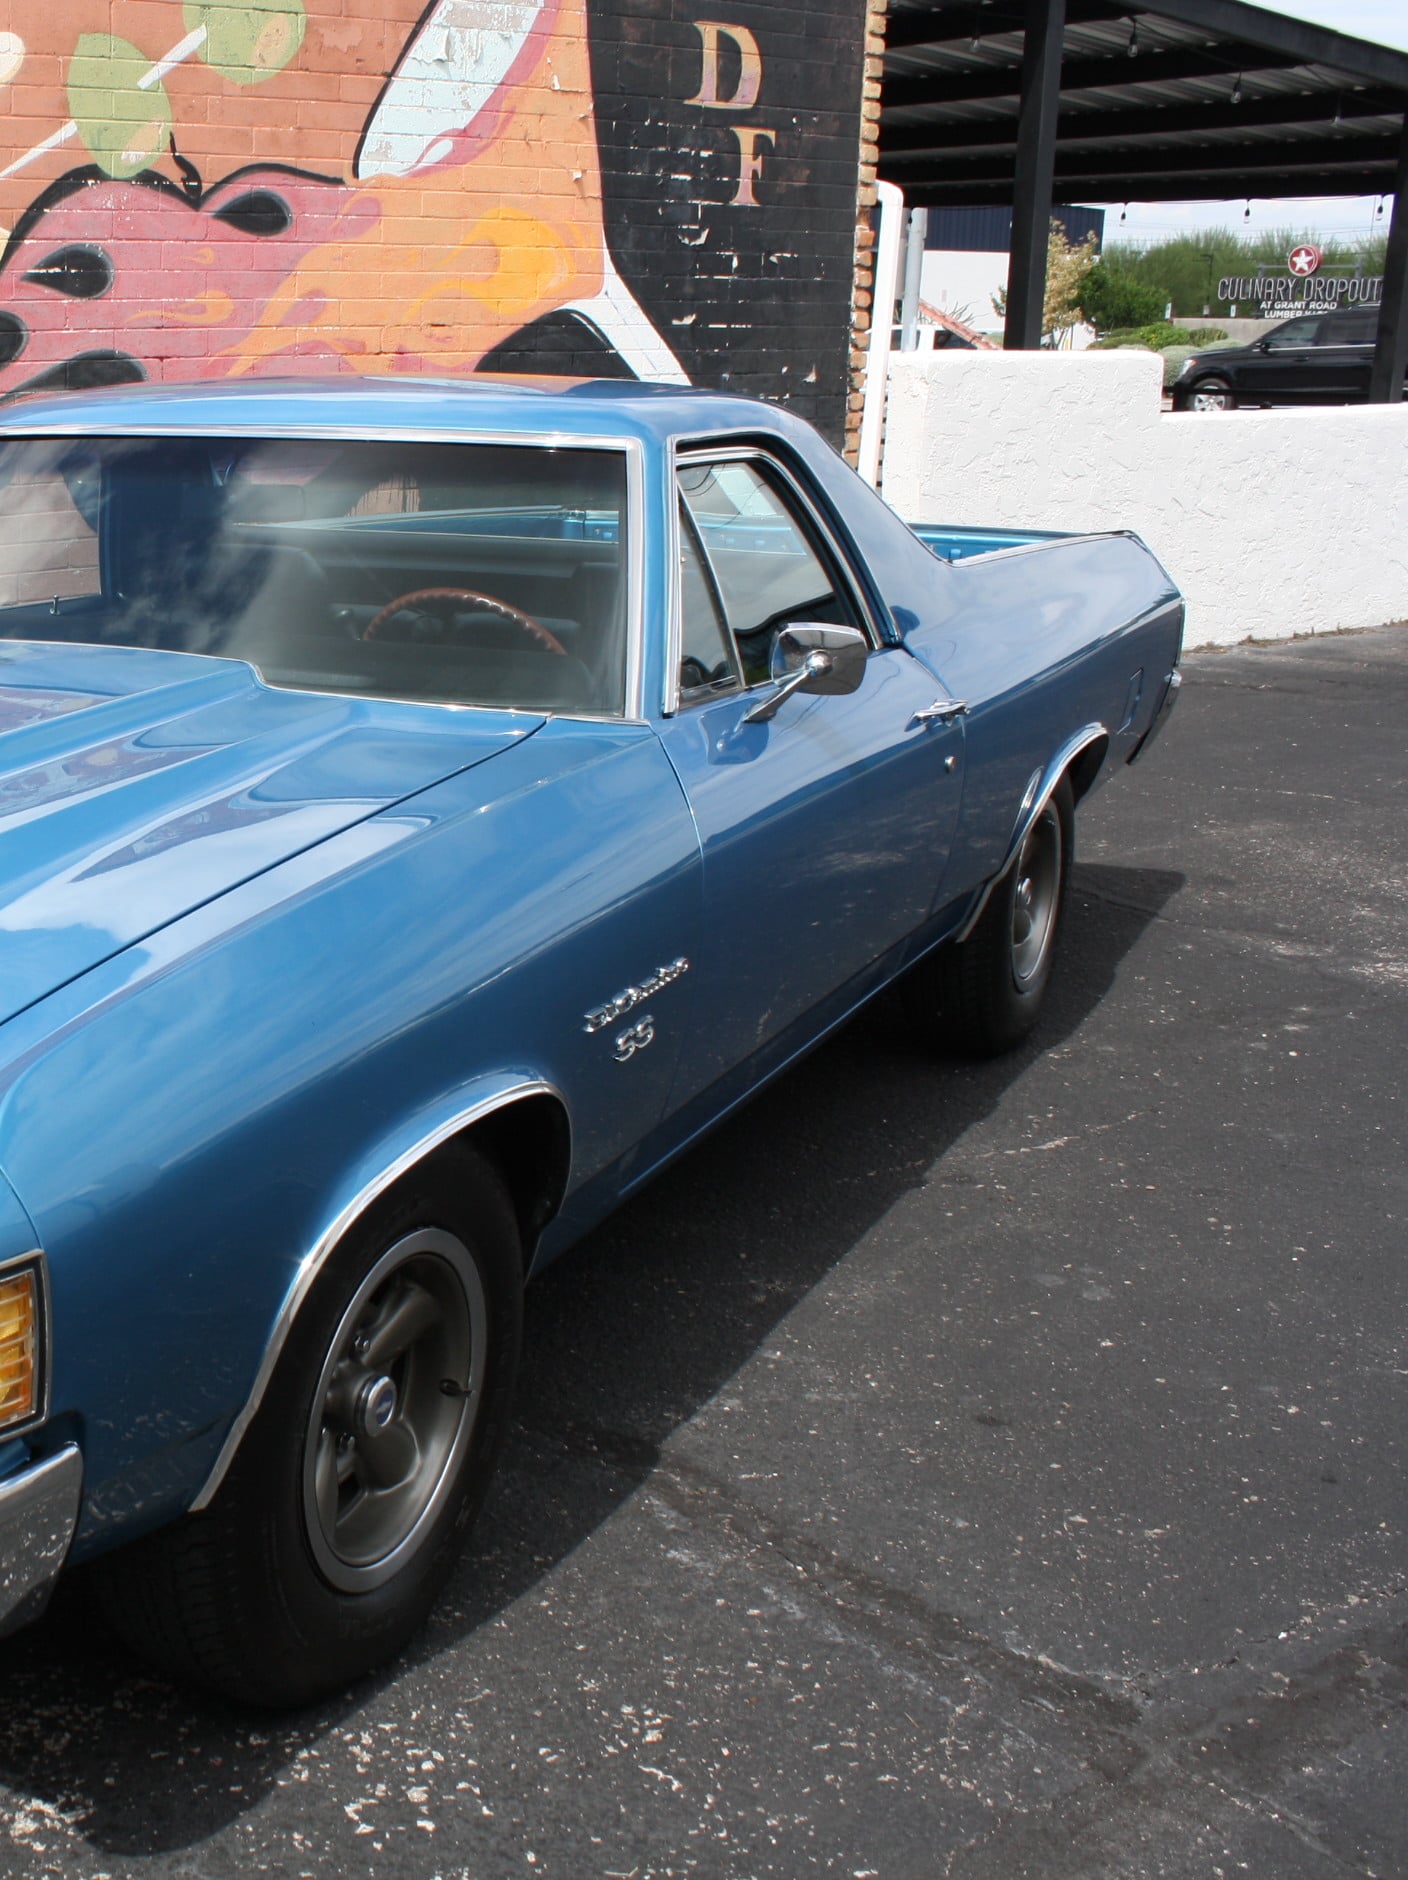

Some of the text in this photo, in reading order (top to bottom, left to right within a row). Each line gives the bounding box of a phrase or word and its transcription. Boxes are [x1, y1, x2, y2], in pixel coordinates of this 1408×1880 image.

[683, 20, 763, 110] D
[729, 126, 777, 206] F
[1217, 276, 1383, 302] CULINARY DROPOUT
[1259, 301, 1338, 310] AT GRANT ROAD
[1264, 310, 1303, 319] LUMBER
[612, 1014, 655, 1062] SS
